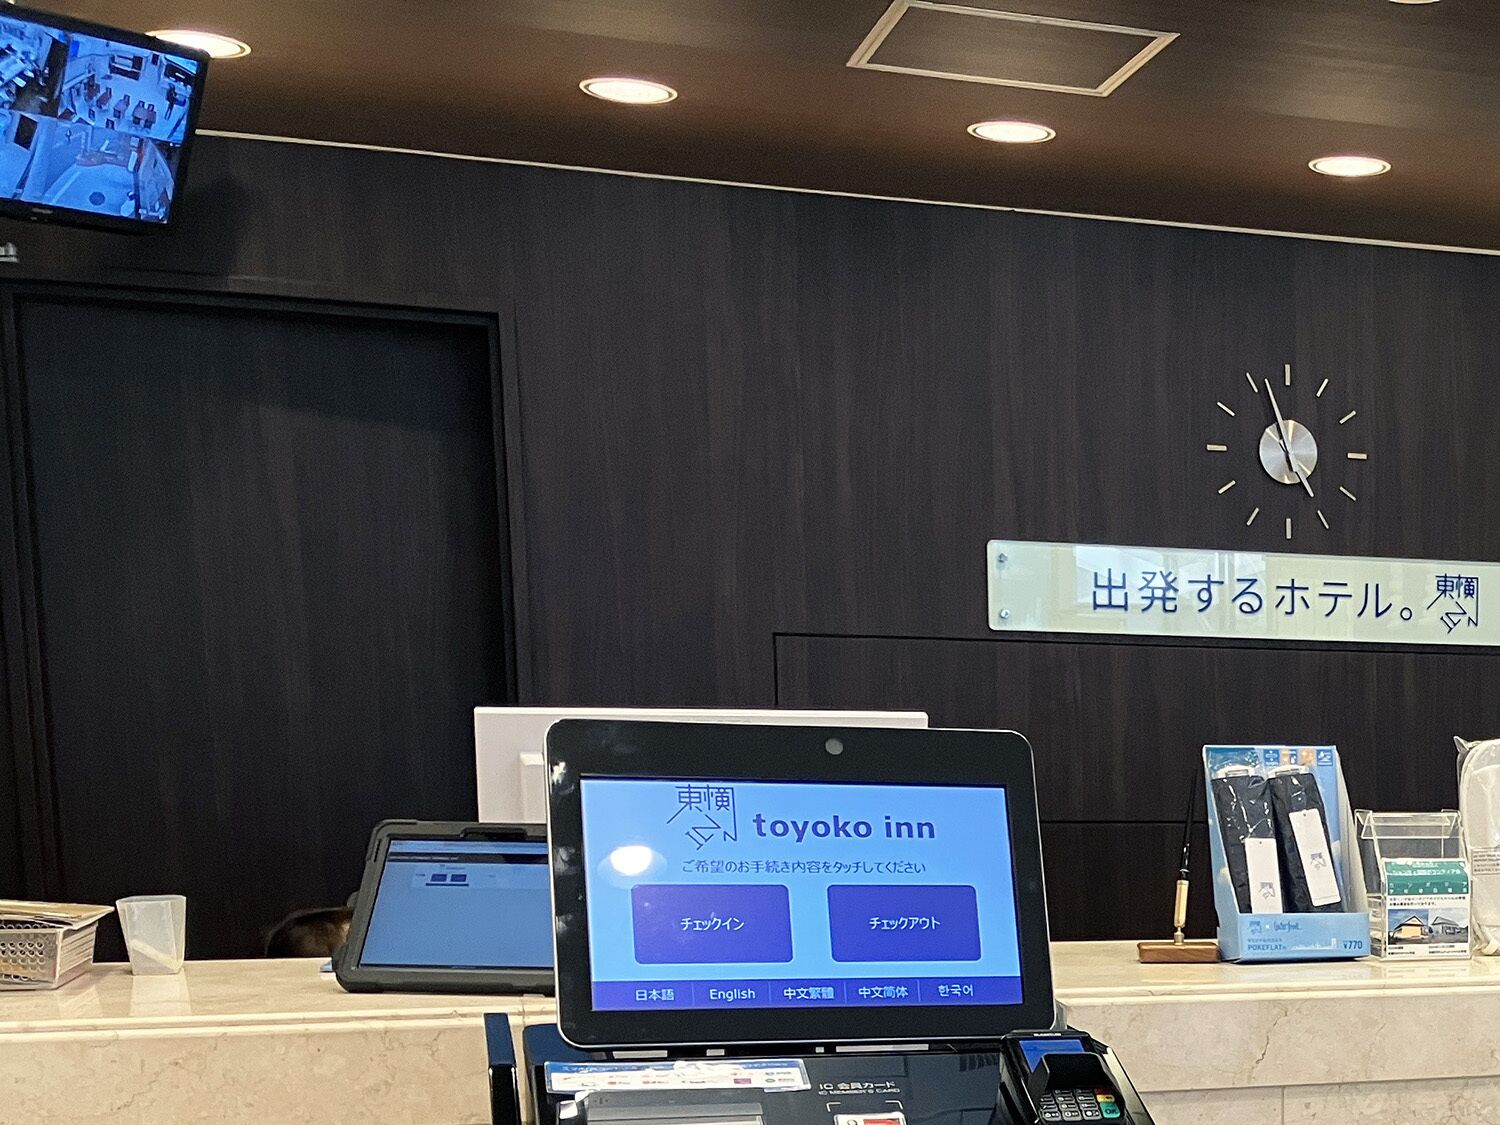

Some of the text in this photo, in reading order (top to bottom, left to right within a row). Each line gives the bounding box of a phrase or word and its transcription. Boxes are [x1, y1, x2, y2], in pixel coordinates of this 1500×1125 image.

[1092, 568, 1413, 622] 出発するホテル。
[752, 813, 936, 843] toyoko inn
[682, 860, 927, 875] ご希望のお手続き内容をタッチしてください
[680, 916, 745, 932] チェックイン
[868, 915, 942, 931] チェックアウト
[635, 988, 675, 1001] 日本語
[709, 987, 756, 1001] English
[937, 983, 975, 998] 한국어
